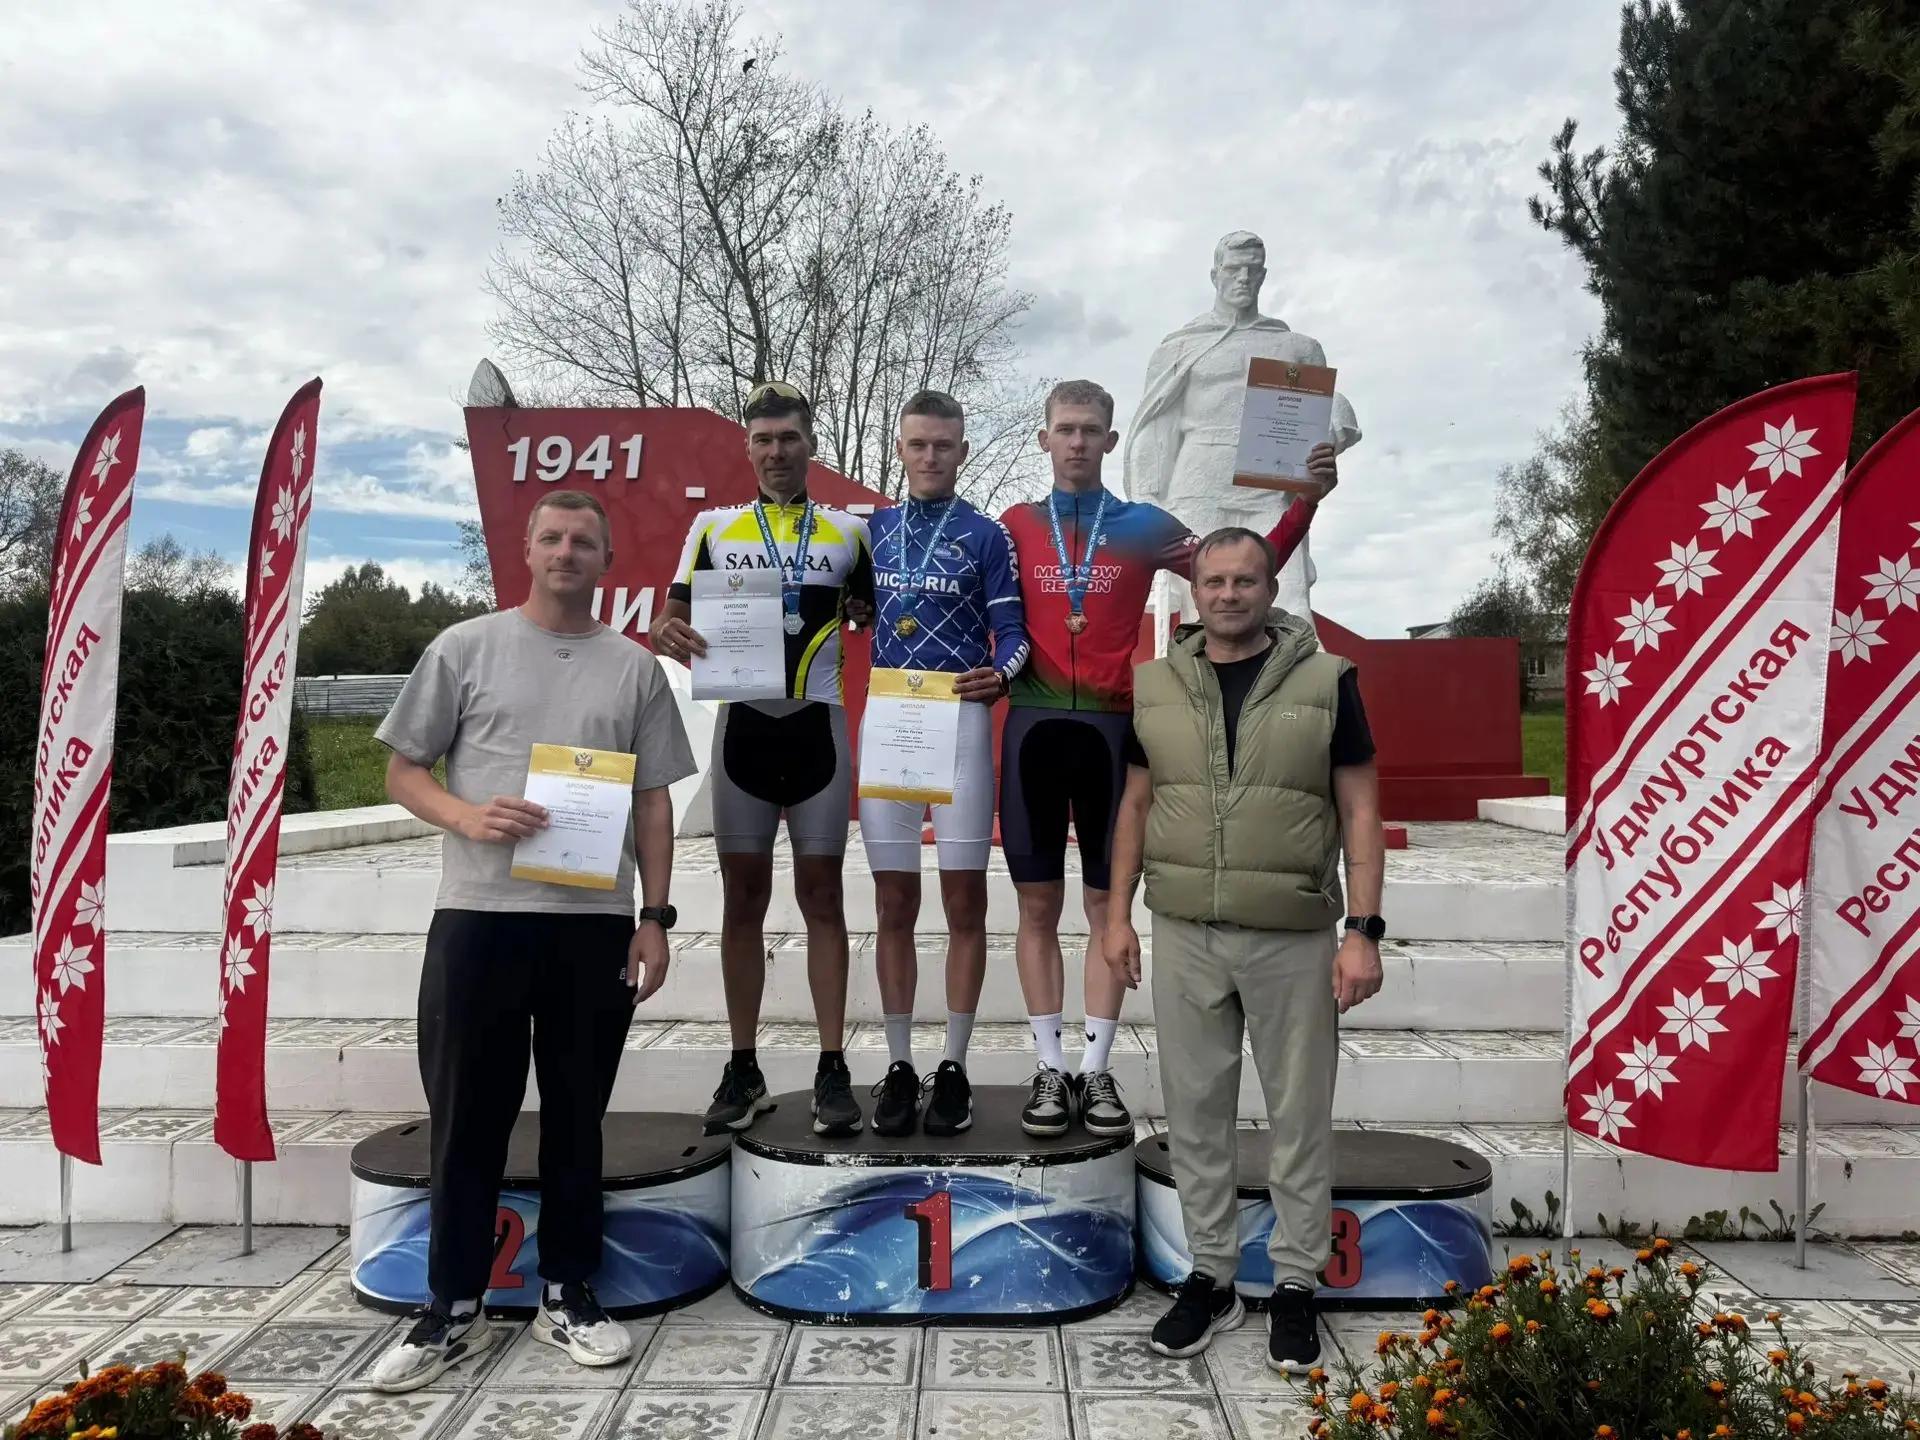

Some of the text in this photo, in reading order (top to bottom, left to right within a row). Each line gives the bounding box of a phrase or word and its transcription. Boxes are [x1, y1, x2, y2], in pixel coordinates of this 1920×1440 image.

[508, 434, 643, 482] 1941
[725, 552, 834, 574] SAMARA
[875, 571, 961, 596] VICORIA
[1034, 565, 1122, 580] MOOW
[1041, 579, 1112, 593] REON
[1595, 619, 1812, 871] Удмуртская
[1839, 735, 1920, 830] Удм
[1580, 735, 1792, 979] Республика
[1836, 828, 1920, 938] Респ
[487, 1206, 524, 1290] 2
[904, 1190, 953, 1290] 1
[1316, 1208, 1363, 1289] 3
